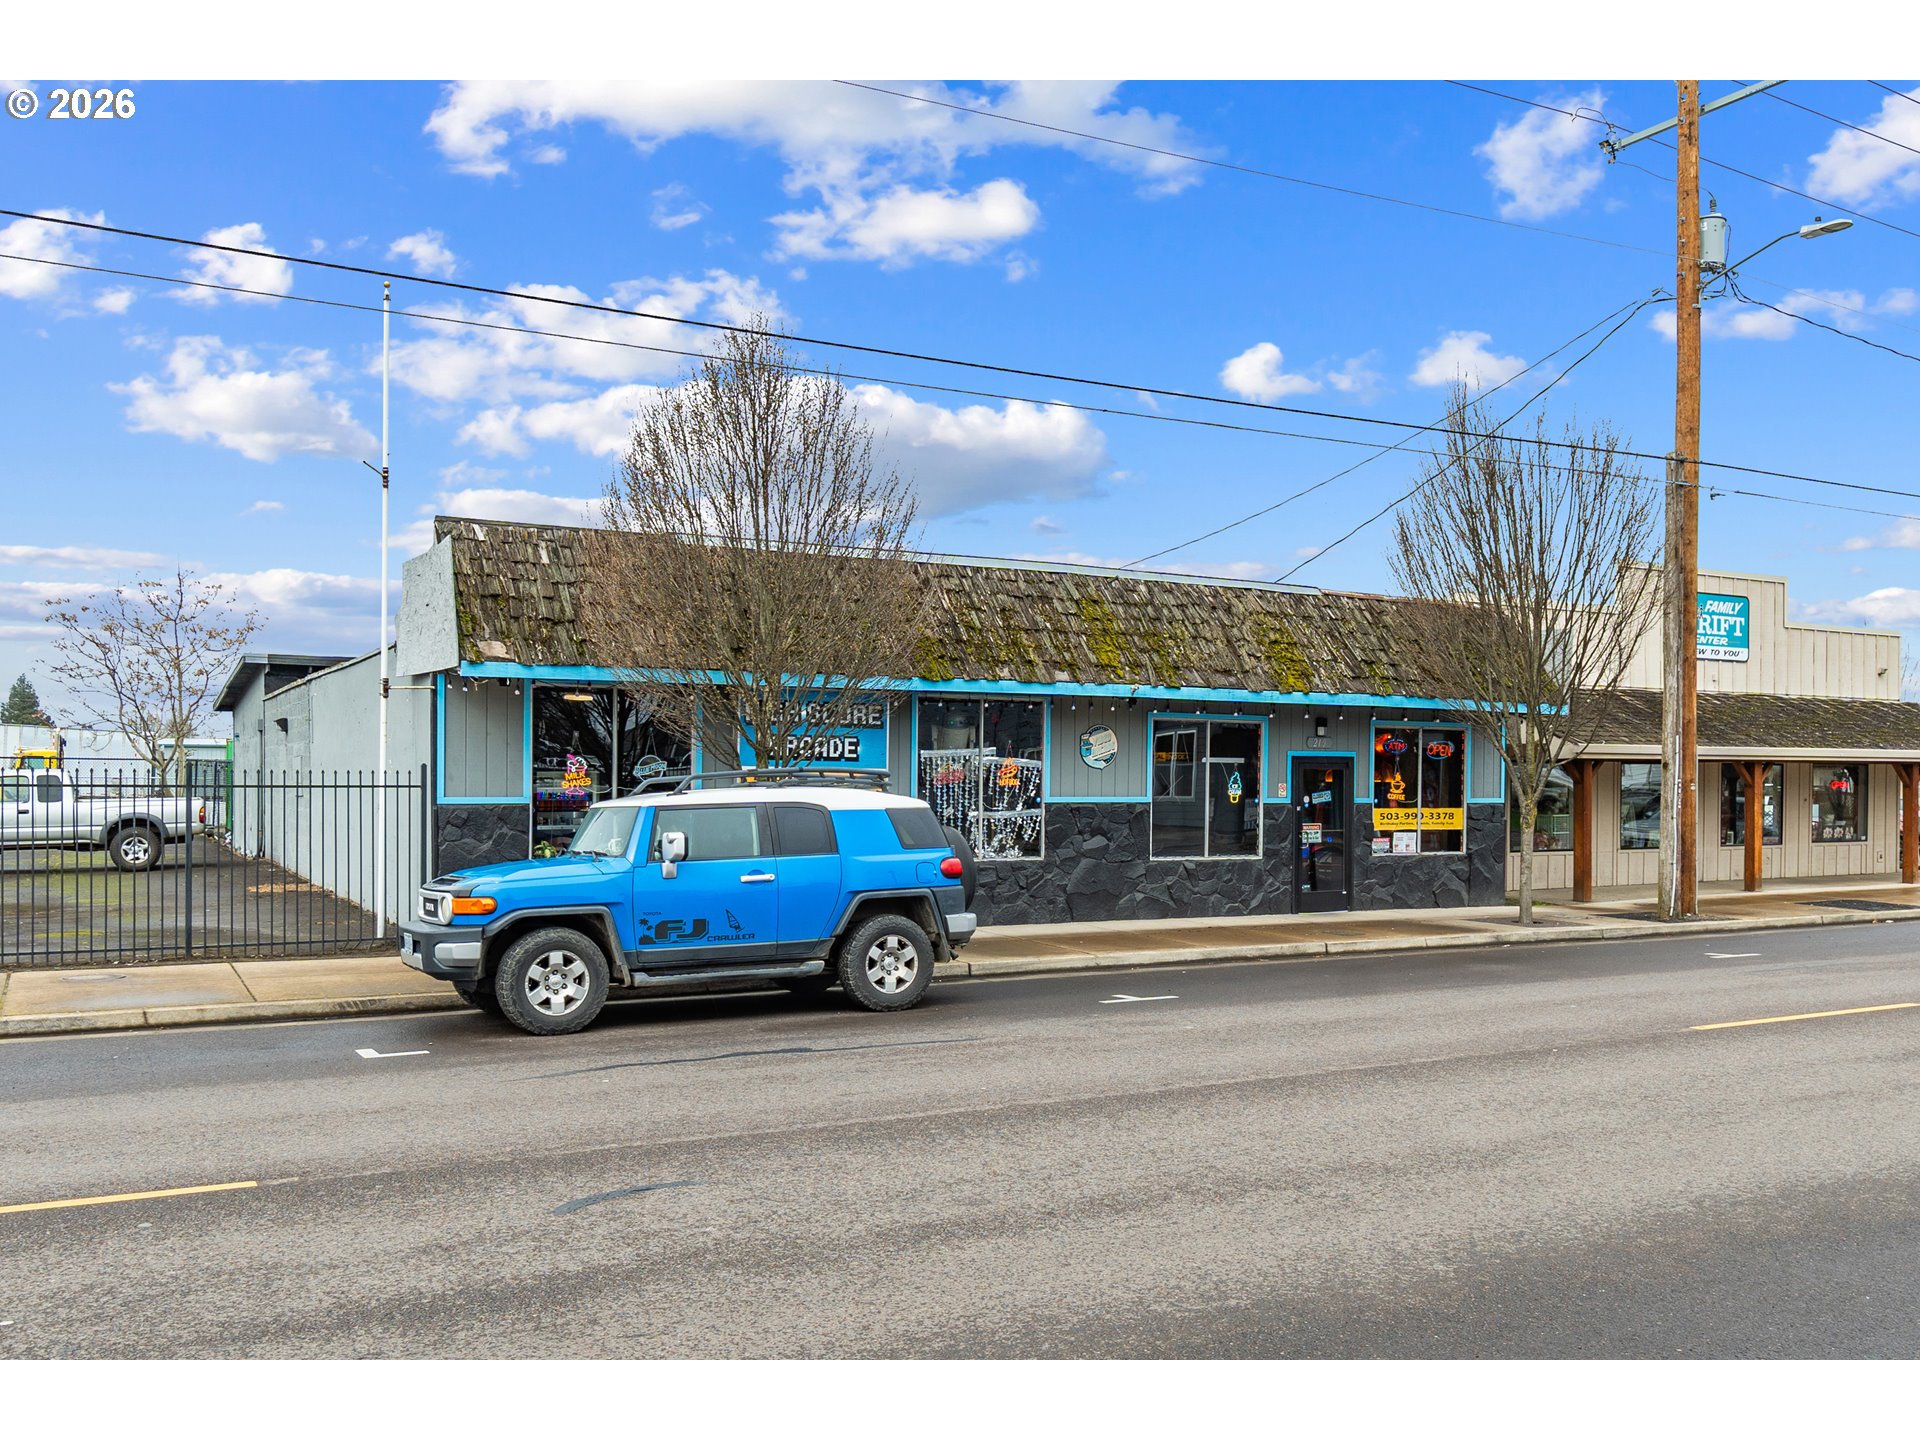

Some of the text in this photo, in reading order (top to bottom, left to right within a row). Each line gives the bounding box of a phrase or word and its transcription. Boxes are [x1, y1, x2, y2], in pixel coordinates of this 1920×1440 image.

[1704, 600, 1744, 615] FAMILY
[1697, 613, 1745, 637] RIFT
[1697, 634, 1729, 646] ENTER
[768, 734, 859, 760] RCADE
[1388, 742, 1405, 750] ATM
[1427, 743, 1452, 757] OPEN
[564, 770, 586, 781] MILK
[561, 777, 592, 789] SHAKES
[655, 919, 709, 941] FJ
[707, 933, 755, 942] CRAWLER
